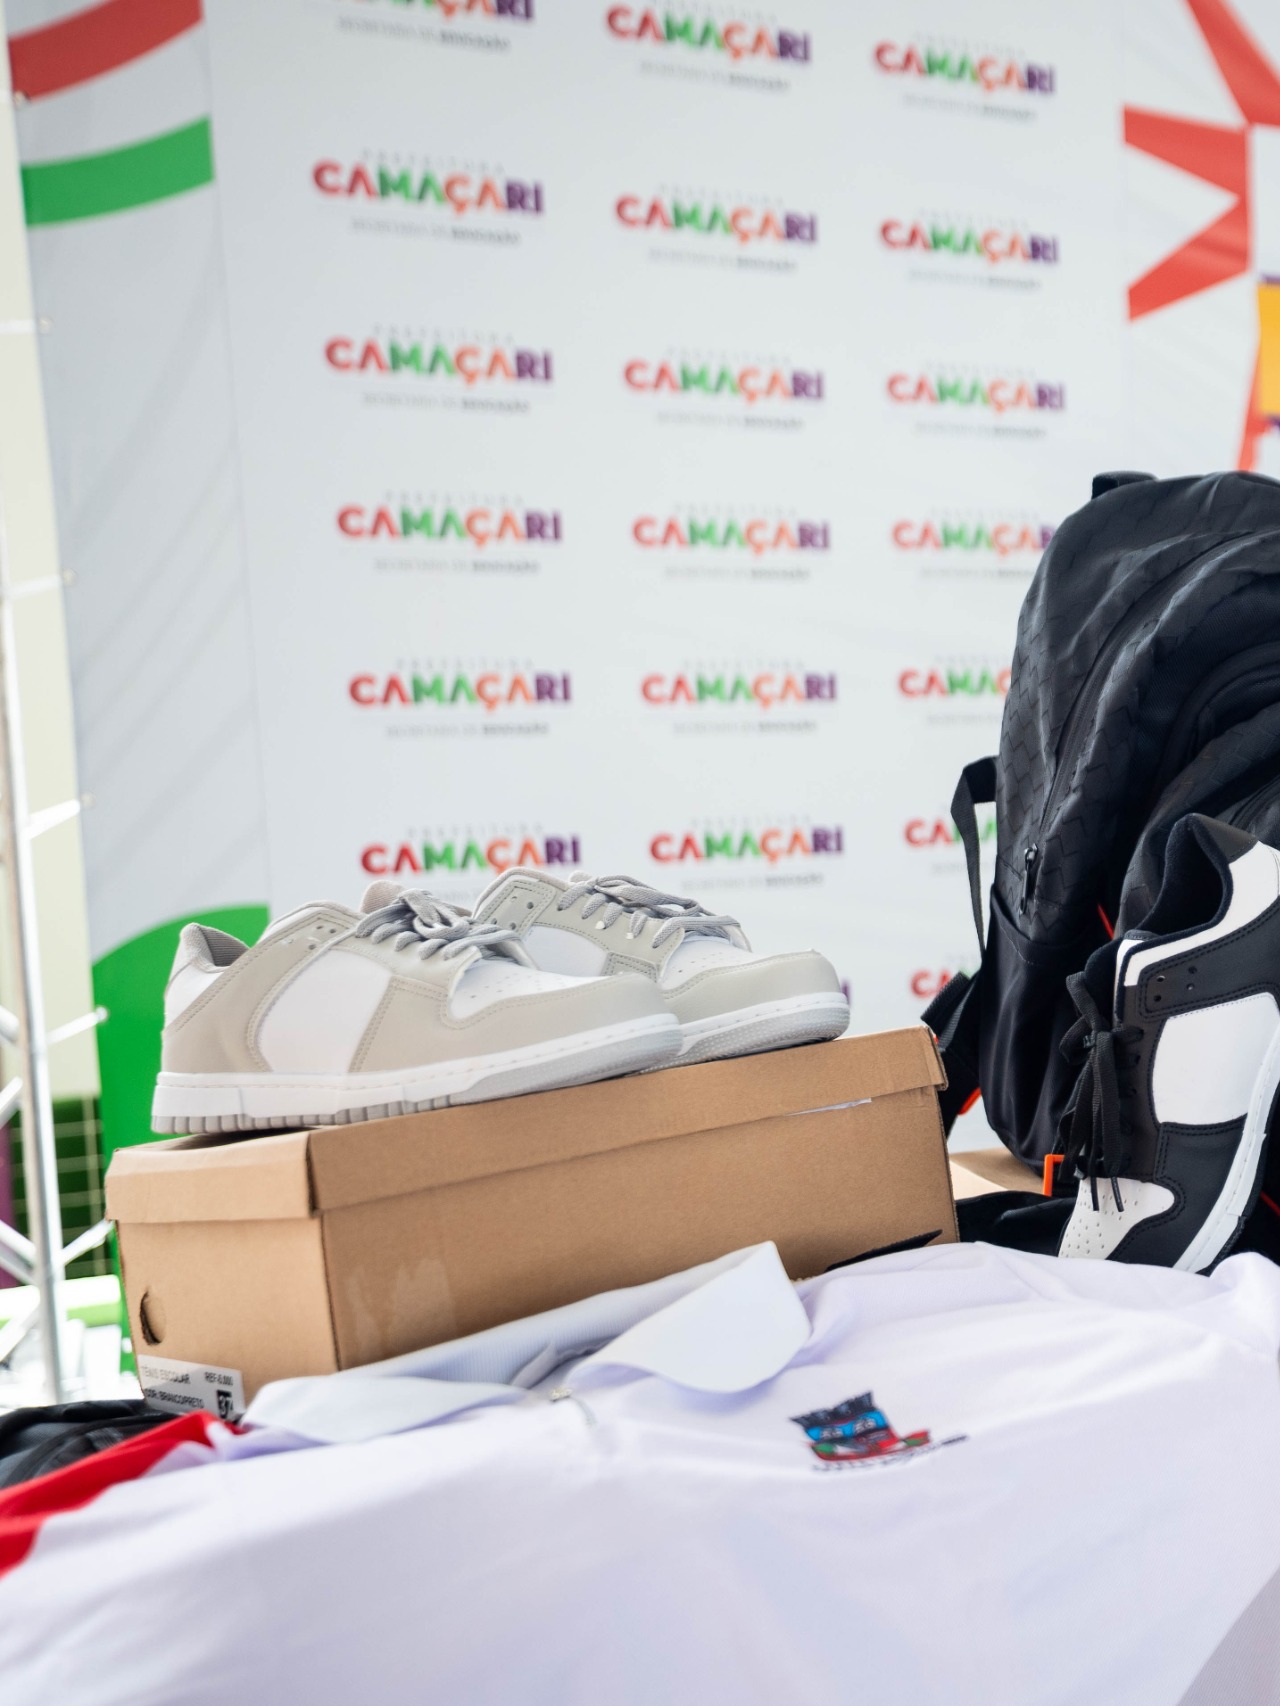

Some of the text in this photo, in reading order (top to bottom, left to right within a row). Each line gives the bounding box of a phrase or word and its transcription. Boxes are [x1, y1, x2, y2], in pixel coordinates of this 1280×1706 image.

[607, 7, 811, 60] CAMAÇARI
[874, 43, 1054, 92] CAMAÇARI
[312, 161, 541, 214] CAMAÇARI
[615, 197, 815, 243] CAMAÇARI
[881, 221, 1056, 263] CAMAÇARI
[325, 338, 551, 385] CAMAÇARI
[624, 361, 821, 402] CAMAÇARI
[887, 376, 1060, 412] CAMAÇARI
[337, 506, 561, 548] CAMAÇARI
[633, 517, 828, 554] CAMAÇARI
[348, 674, 570, 711] CAMAÇARI
[641, 674, 835, 708] CAMAÇARI
[360, 838, 580, 875] CAMAÇARI
[649, 829, 841, 864] CAMAÇARI
